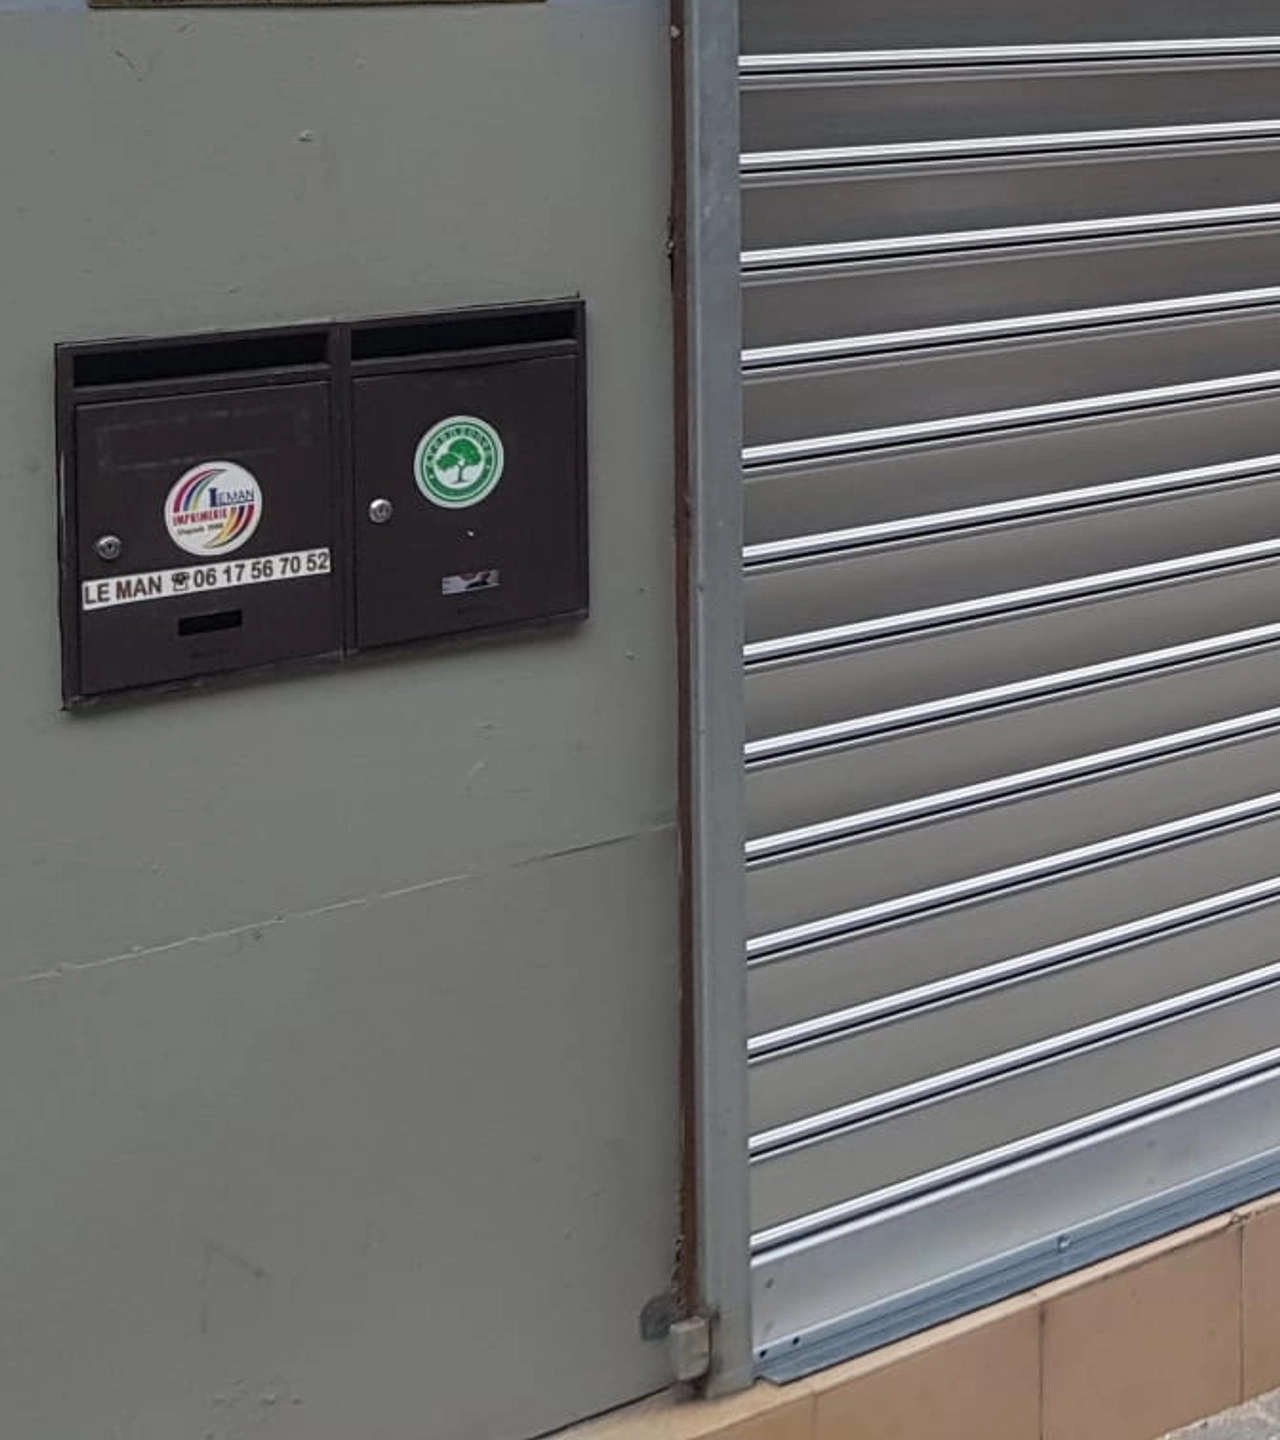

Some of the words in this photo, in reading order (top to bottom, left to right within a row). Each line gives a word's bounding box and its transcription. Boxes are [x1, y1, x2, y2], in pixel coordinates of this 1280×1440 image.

[171, 507, 228, 527] IMPRIMERIE
[84, 582, 110, 606] LE
[115, 574, 163, 602] MAN
[193, 565, 217, 589] 06
[222, 563, 245, 585] 17
[251, 559, 274, 582] 56
[279, 555, 302, 578] 70
[306, 551, 330, 574] 52
